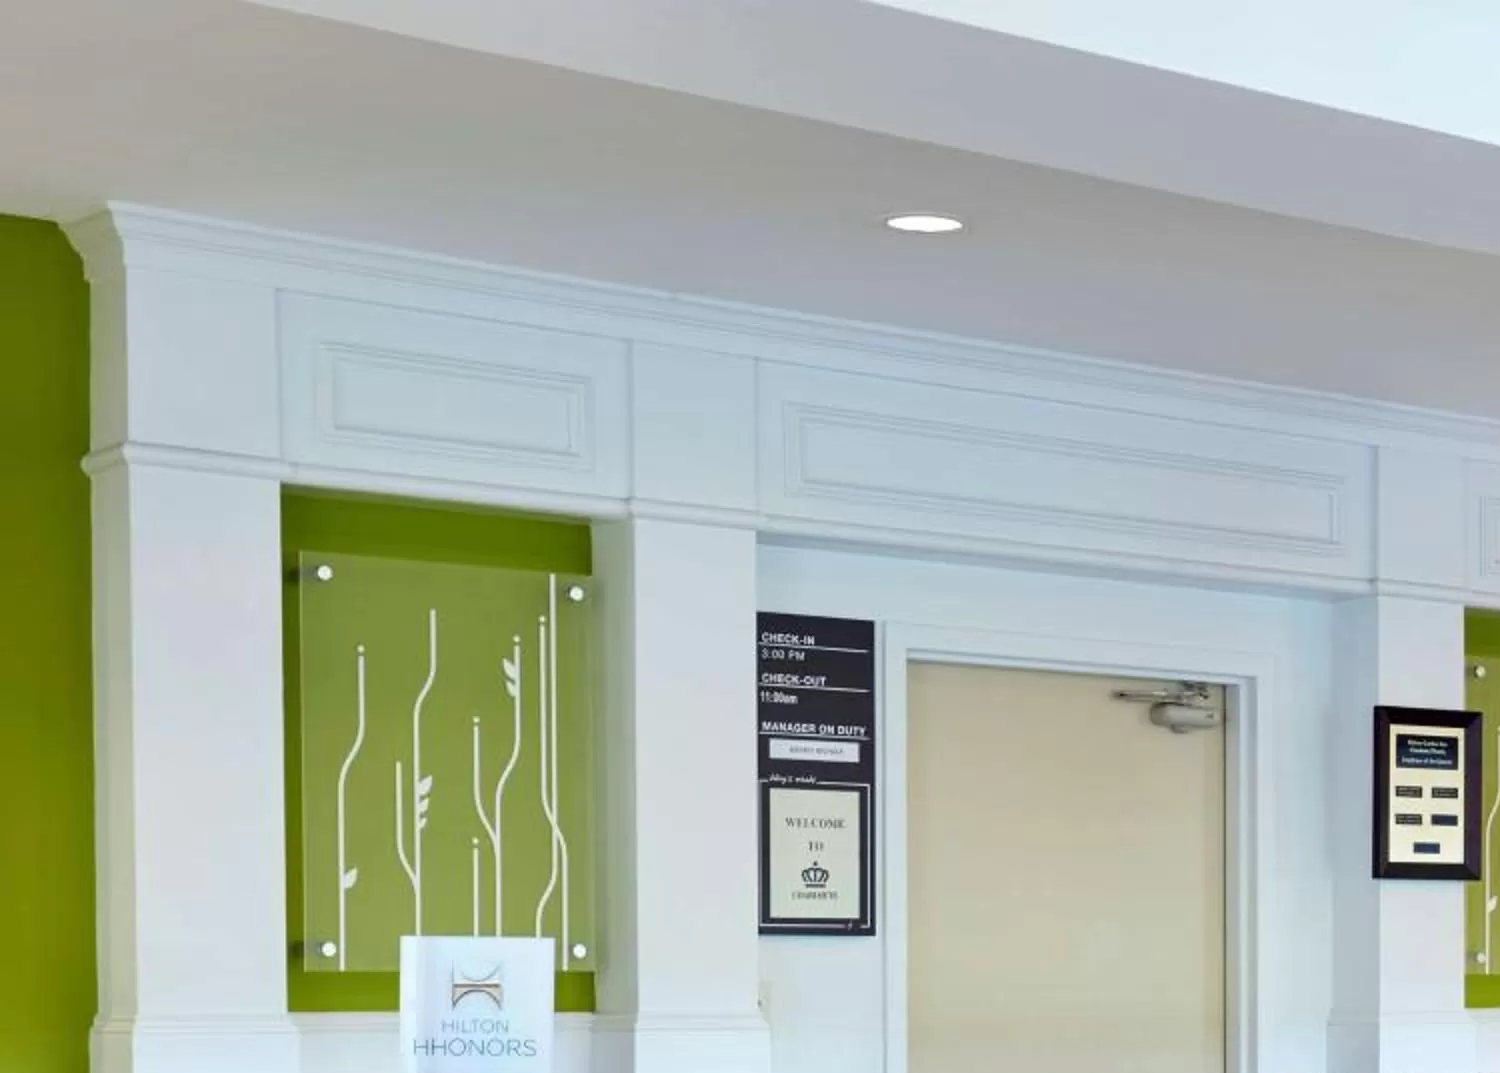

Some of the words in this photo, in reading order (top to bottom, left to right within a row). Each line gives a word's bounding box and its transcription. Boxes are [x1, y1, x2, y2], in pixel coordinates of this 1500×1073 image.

[761, 632, 815, 646] CHECK-IN
[788, 650, 805, 662] PM
[761, 673, 826, 687] CHECK-OUT
[761, 721, 816, 733] MANAGER
[818, 724, 835, 735] ON
[837, 725, 866, 737] DUTY
[784, 817, 846, 829] WELCOME
[440, 1019, 509, 1035] HILTON
[413, 1036, 537, 1057] HHONORS
